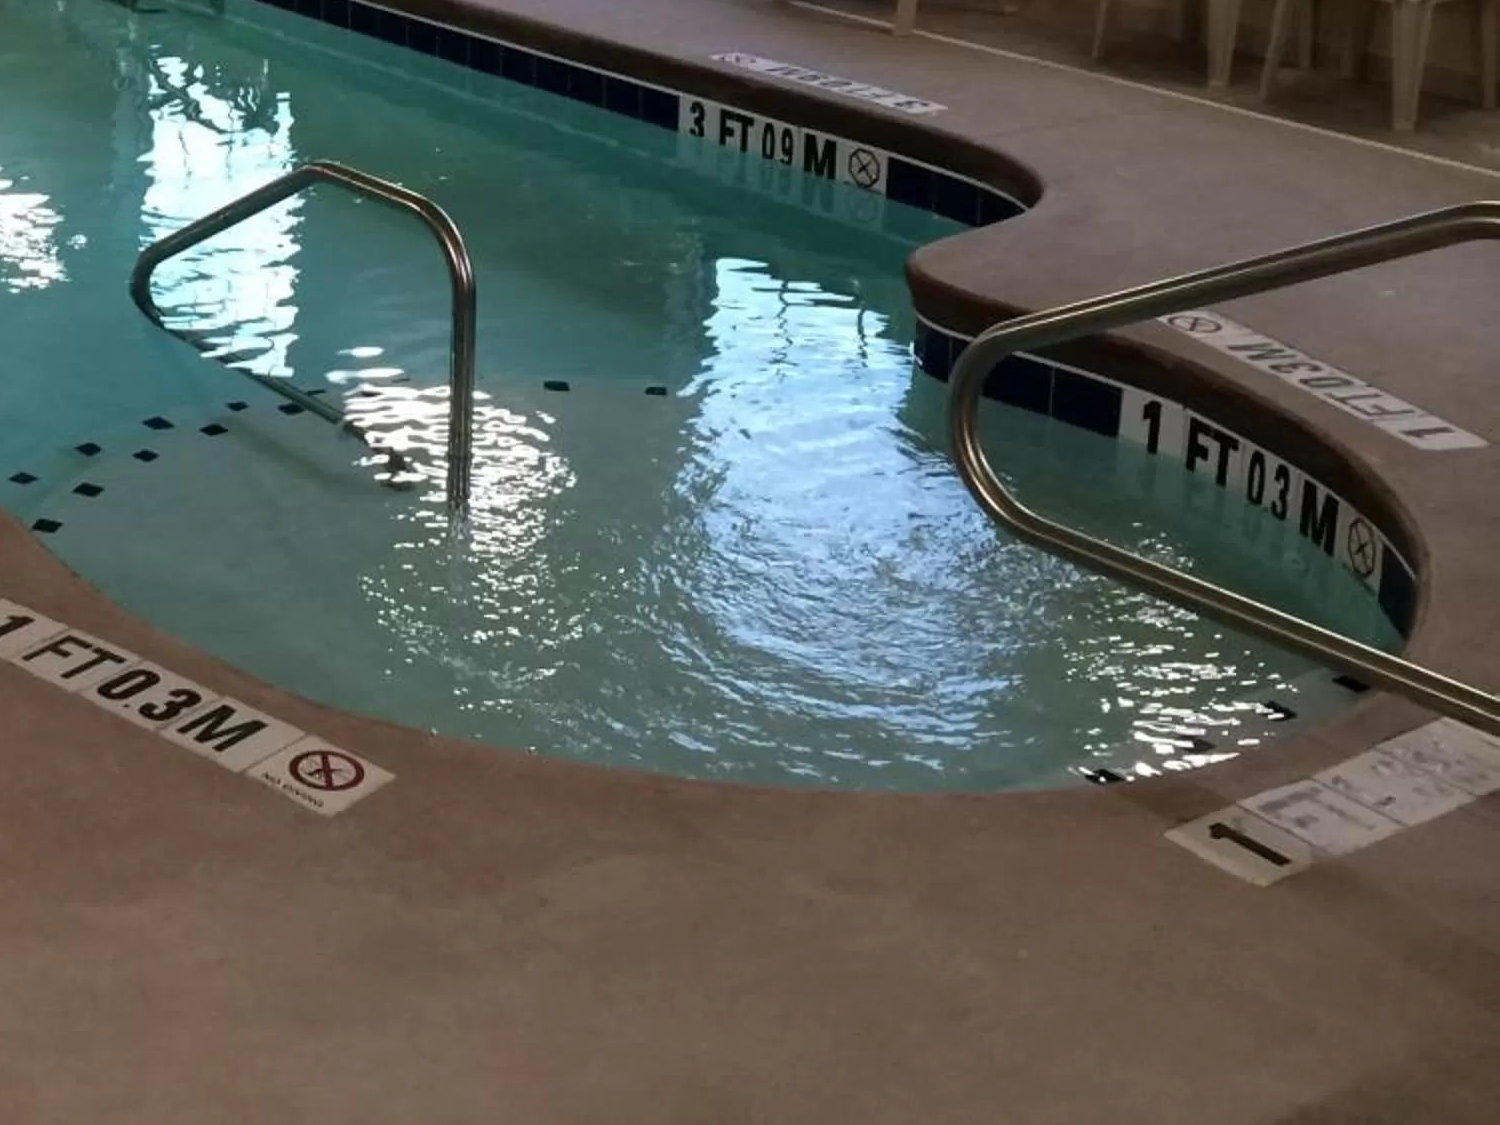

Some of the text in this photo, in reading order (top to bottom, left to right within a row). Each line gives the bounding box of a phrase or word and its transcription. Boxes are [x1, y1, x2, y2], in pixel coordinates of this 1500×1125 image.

[689, 101, 705, 138] 3
[719, 108, 755, 153] FT
[803, 132, 837, 180] M
[1227, 341, 1298, 362] M
[1324, 391, 1415, 417] FT
[1143, 399, 1162, 455] 1
[1186, 417, 1239, 488] FT
[1299, 479, 1340, 557] M
[21, 634, 126, 680] FT
[176, 703, 268, 753] M
[1209, 822, 1293, 867] 1
